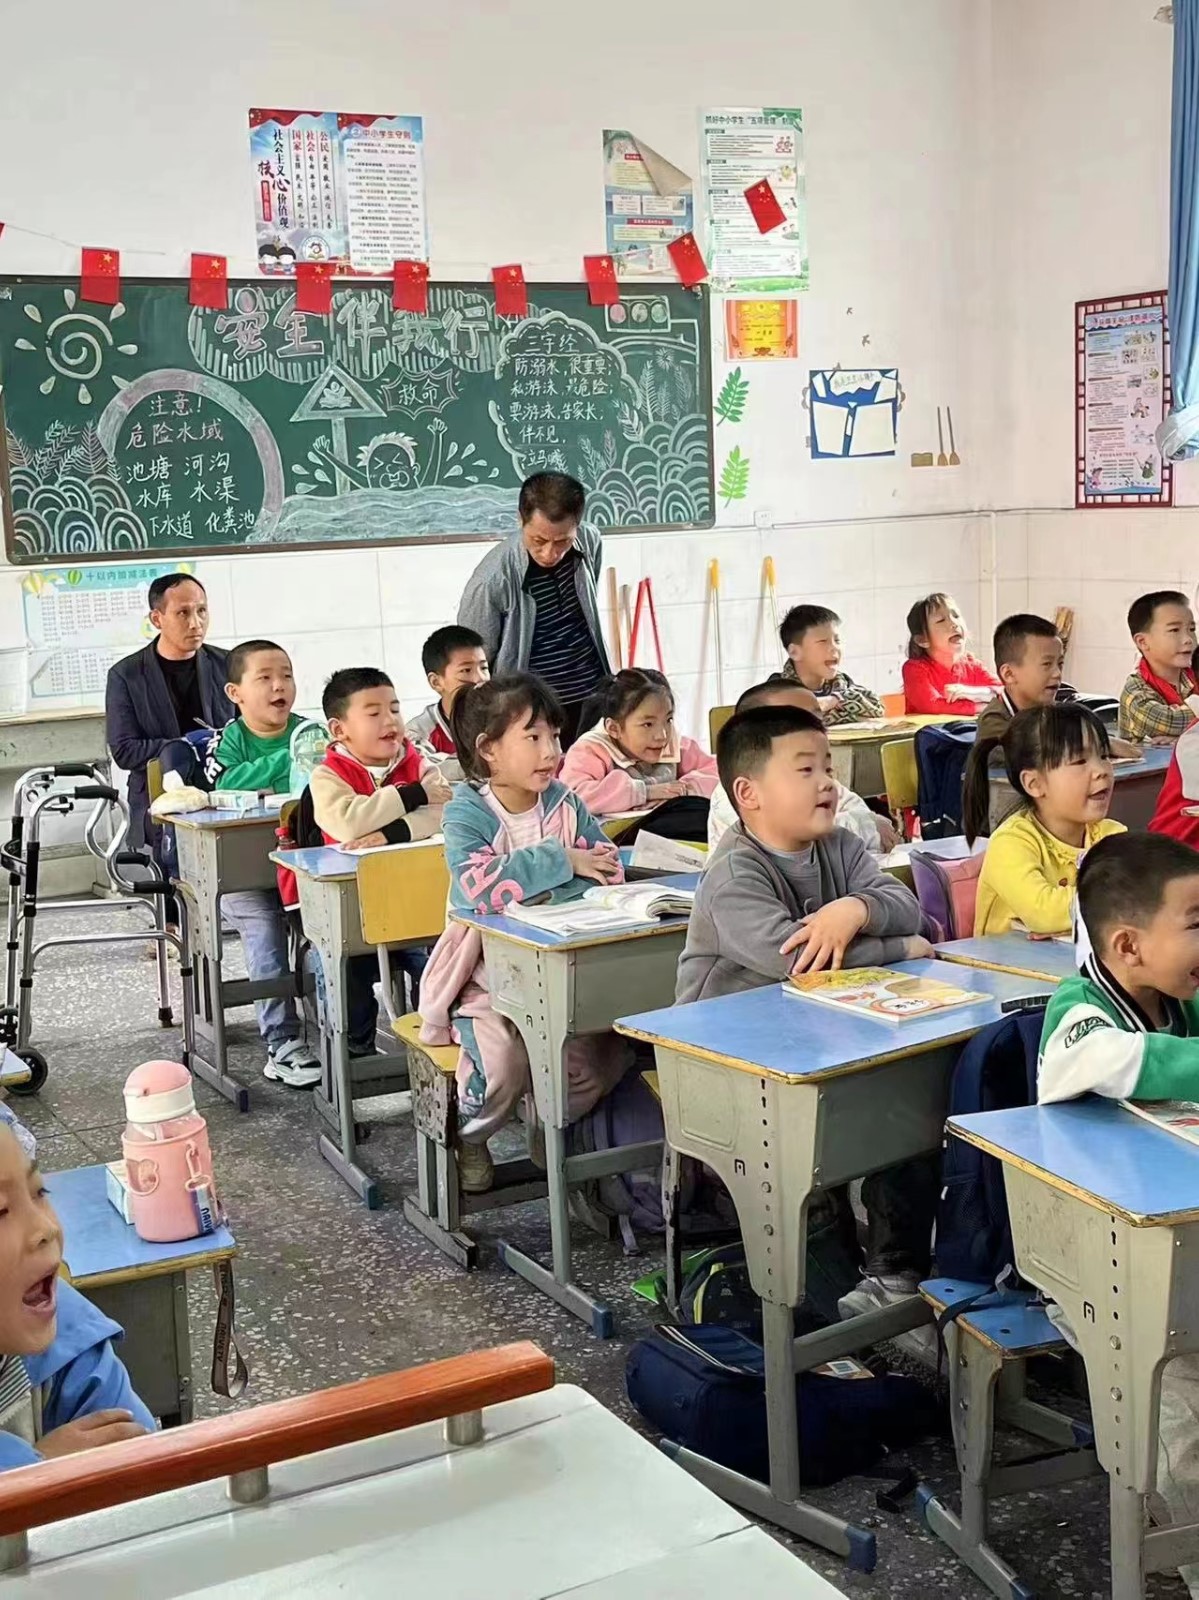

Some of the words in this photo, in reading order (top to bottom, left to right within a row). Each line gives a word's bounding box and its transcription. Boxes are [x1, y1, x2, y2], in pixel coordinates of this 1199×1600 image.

[273, 128, 285, 176] 社会主义
[524, 332, 580, 354] 三字经
[398, 378, 441, 406] 救命
[126, 418, 224, 450] 危险水域
[126, 455, 173, 484] 池塘
[184, 452, 230, 477] 河沟
[135, 482, 173, 509] 水库
[189, 475, 240, 504] 水渠
[149, 510, 194, 539] 下水道
[205, 506, 255, 535] 化粪池
[87, 568, 158, 581] 十以内加减法表
